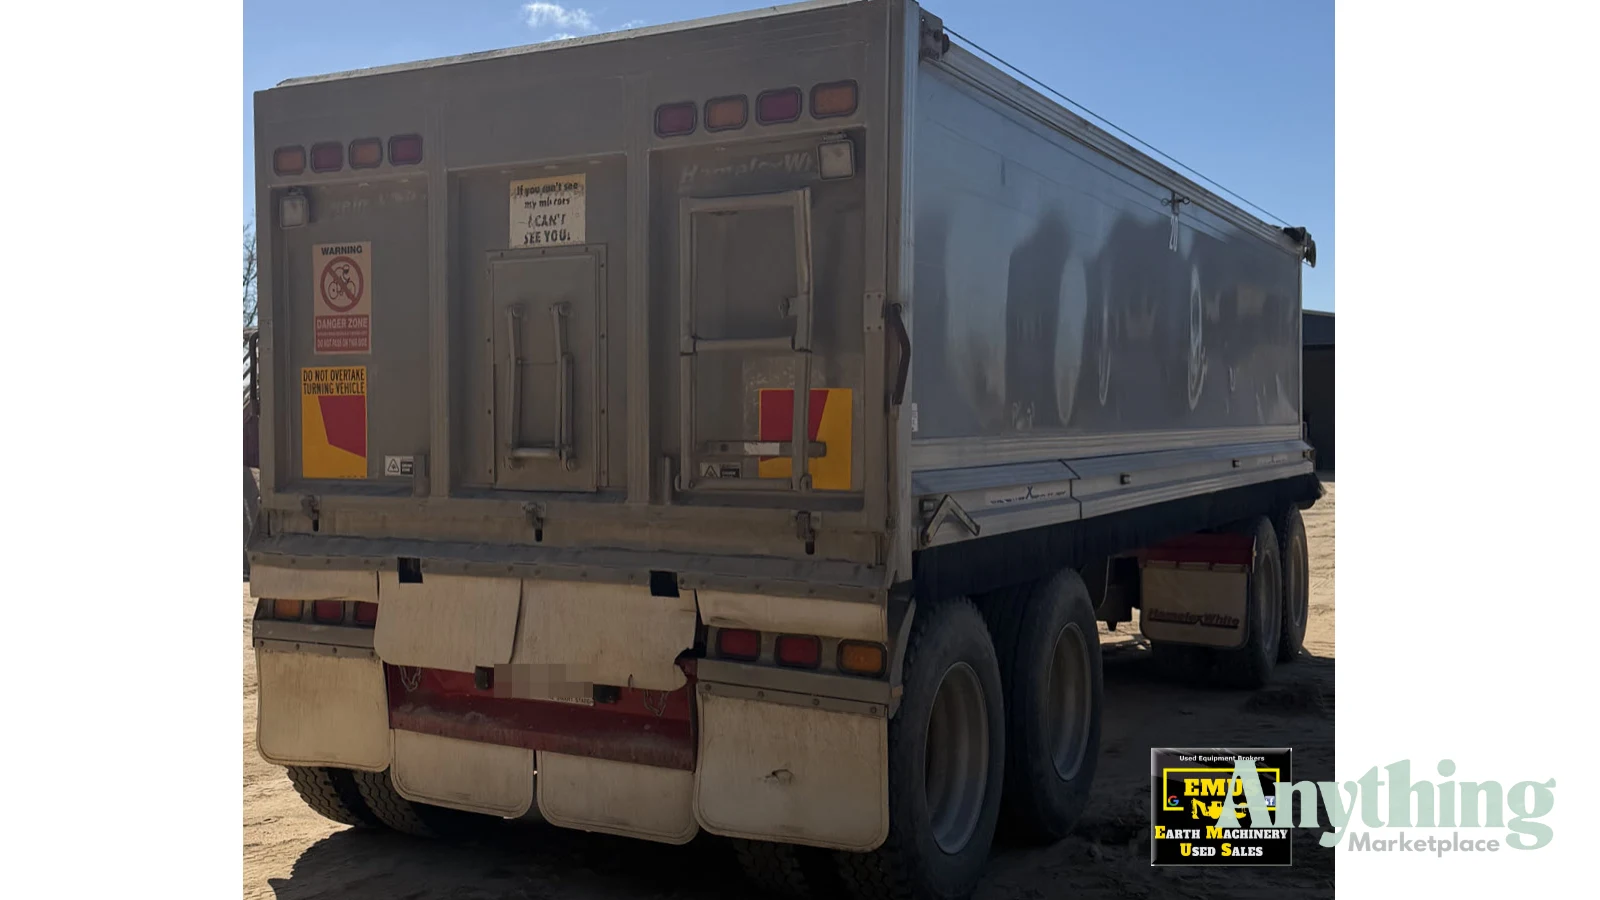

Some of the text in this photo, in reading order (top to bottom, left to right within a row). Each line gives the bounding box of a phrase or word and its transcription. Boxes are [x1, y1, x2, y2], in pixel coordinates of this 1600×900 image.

[516, 184, 524, 196] If
[524, 185, 541, 198] you
[563, 182, 579, 191] see
[524, 200, 537, 210] my
[534, 213, 566, 227] CAN'T
[523, 231, 542, 245] SEE
[321, 245, 363, 256] WARNING
[316, 317, 368, 329] DANGER ZONE
[303, 368, 365, 382] DO NOT OVERTAKE
[303, 381, 365, 395] TURNING VEHICLE
